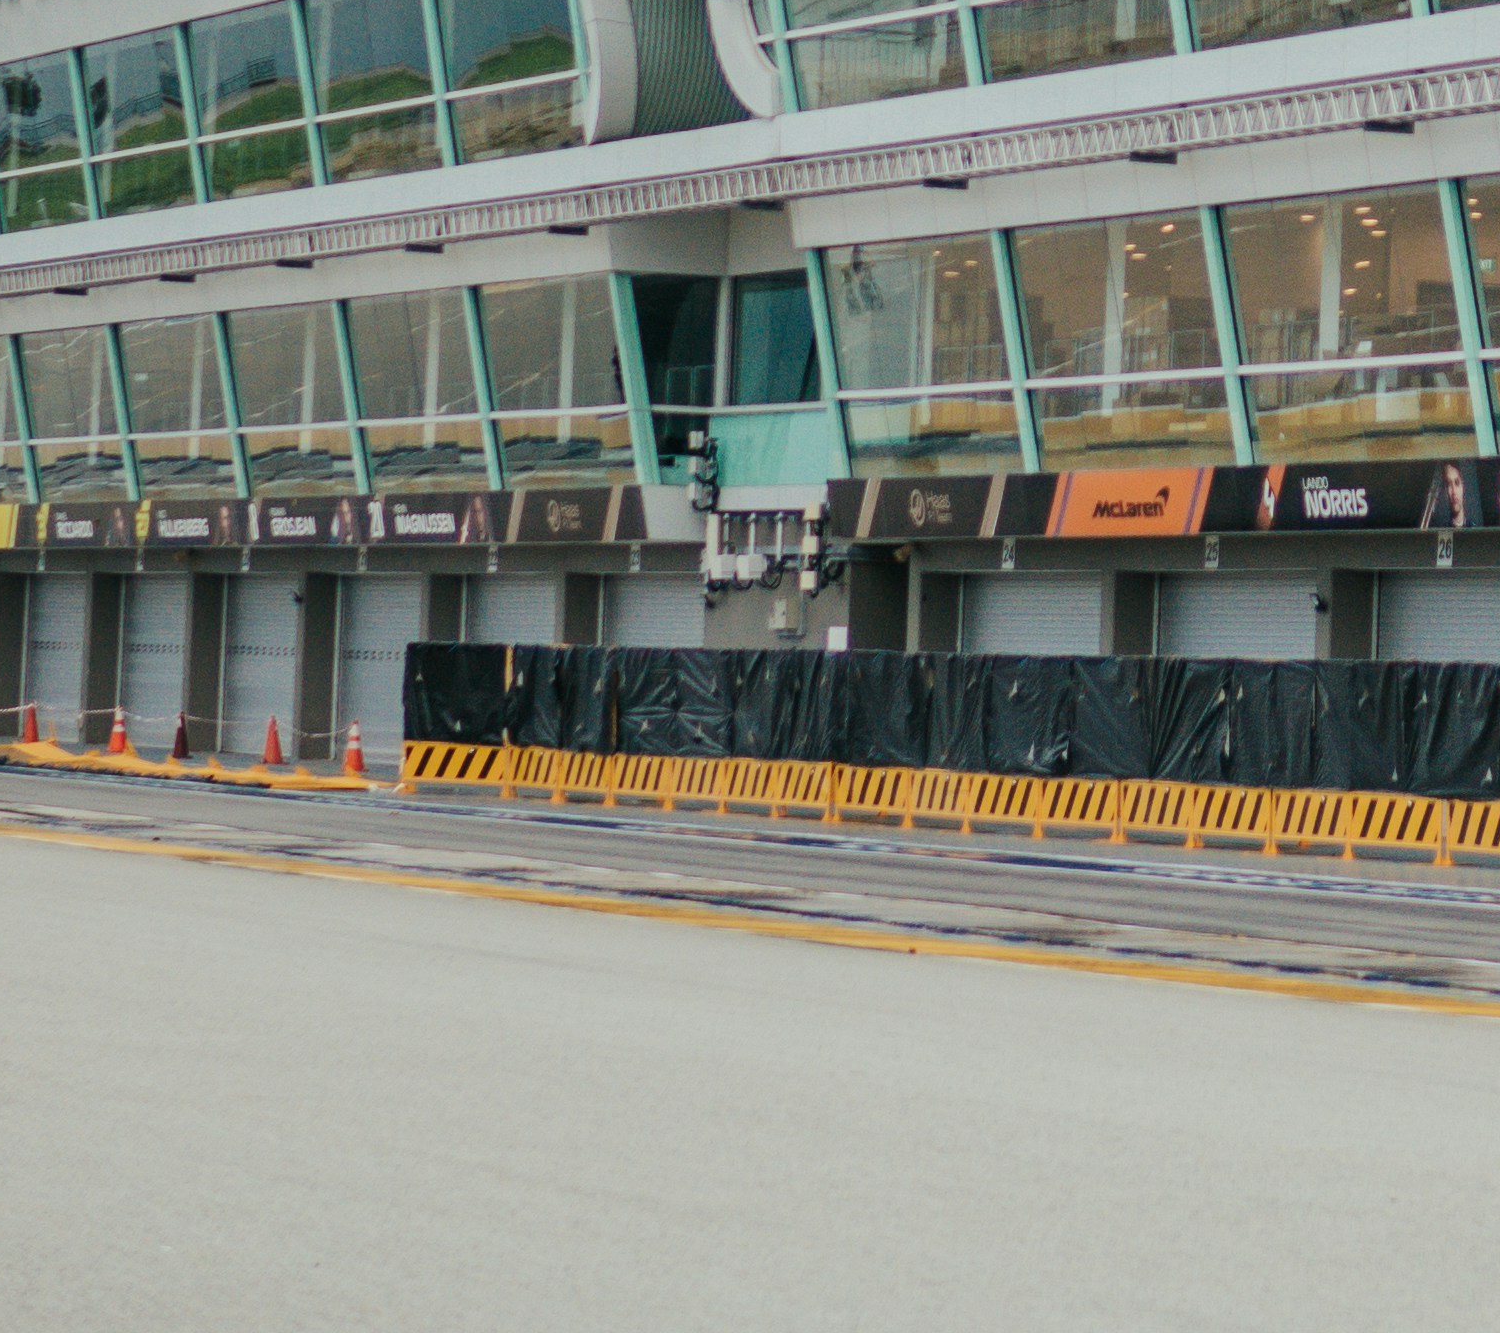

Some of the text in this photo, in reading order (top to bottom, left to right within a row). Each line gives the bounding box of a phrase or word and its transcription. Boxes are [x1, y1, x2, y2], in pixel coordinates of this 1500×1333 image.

[1302, 476, 1329, 490] LANDO
[1092, 497, 1165, 520] McLaren
[1304, 488, 1369, 518] NORRIS
[1003, 540, 1015, 562] 24
[1205, 540, 1218, 562] 25
[1437, 538, 1451, 559] 26
